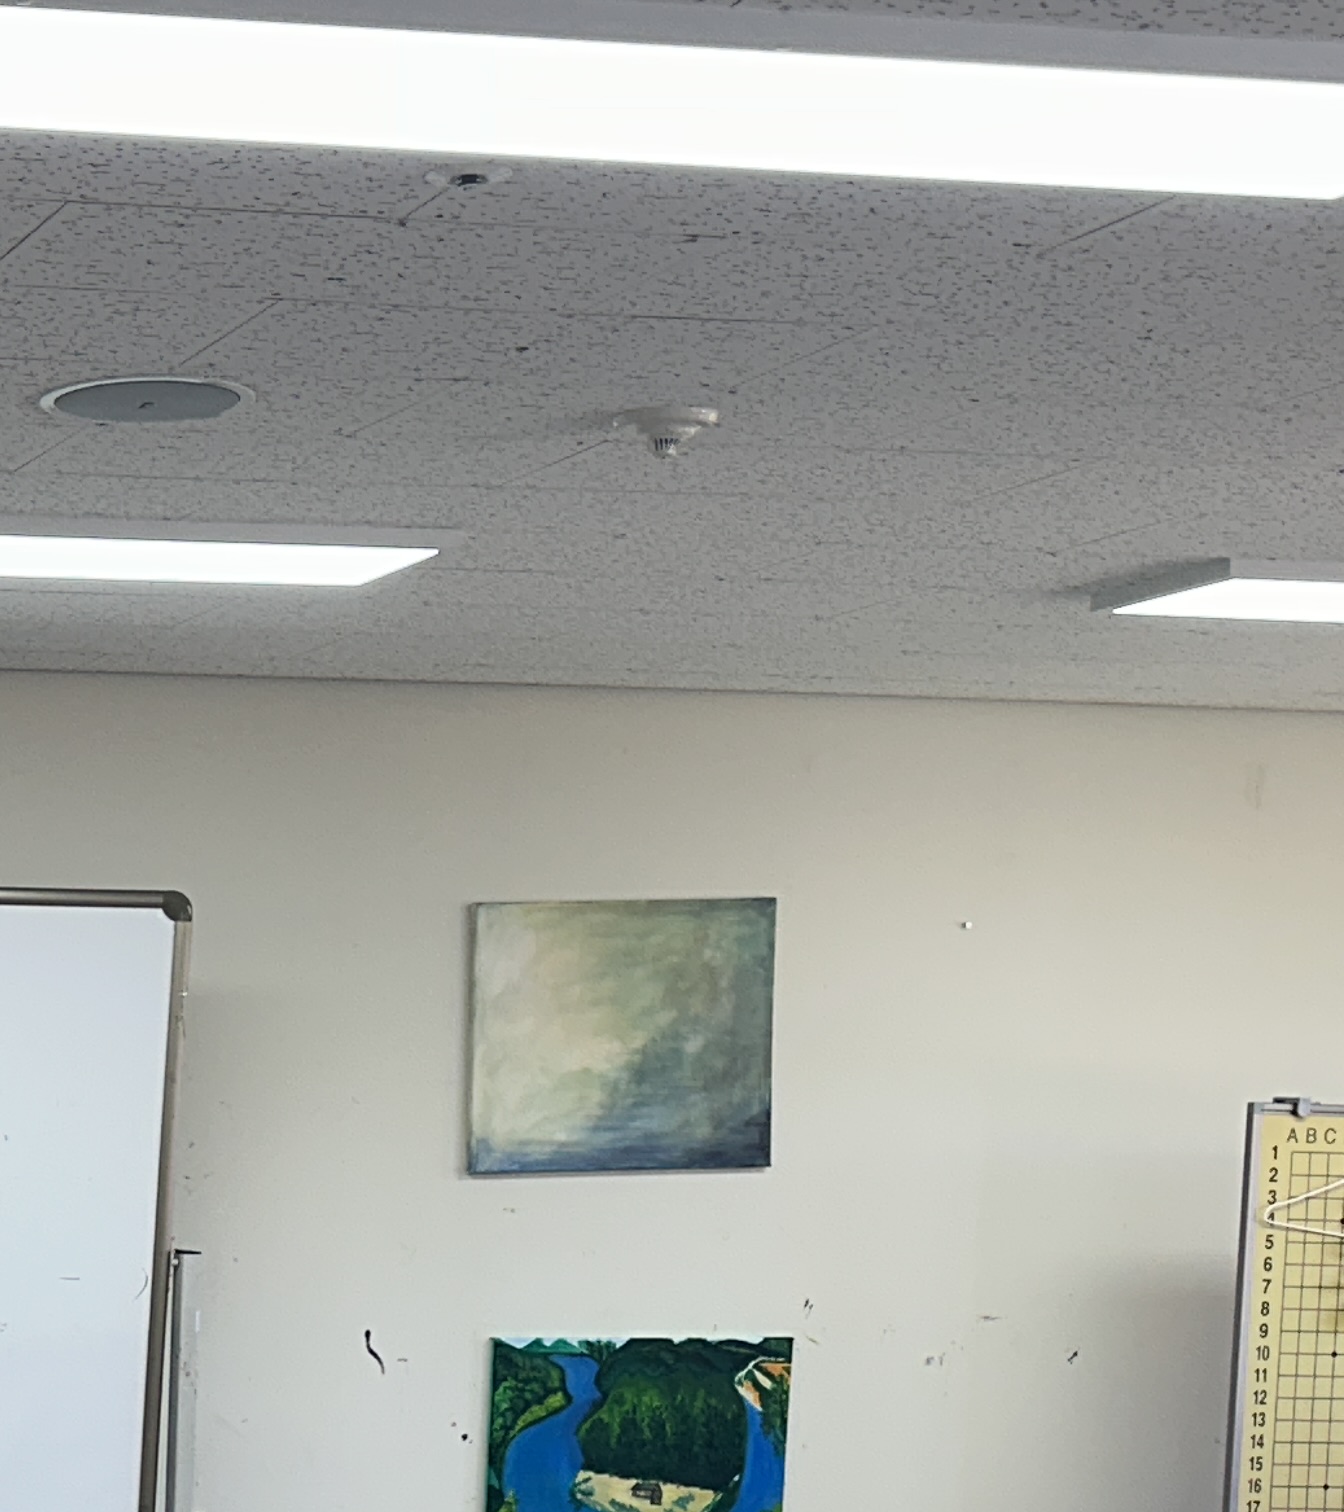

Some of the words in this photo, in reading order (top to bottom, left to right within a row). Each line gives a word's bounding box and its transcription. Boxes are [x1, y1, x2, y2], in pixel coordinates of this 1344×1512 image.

[1286, 1128, 1298, 1143] A
[1306, 1128, 1317, 1144] B
[1324, 1128, 1337, 1144] C
[1272, 1145, 1278, 1160] 1
[1269, 1167, 1278, 1182] 2
[1267, 1190, 1277, 1205] 3
[1264, 1234, 1274, 1249] 5
[1264, 1257, 1272, 1272] 6
[1262, 1279, 1272, 1294] 7
[1261, 1301, 1270, 1316] 8
[1259, 1323, 1269, 1338] 9
[1256, 1345, 1270, 1361] 10
[1254, 1368, 1267, 1383] 11
[1253, 1389, 1267, 1405] 12
[1251, 1412, 1266, 1427] 13
[1250, 1434, 1264, 1449] 14
[1249, 1456, 1263, 1471] 15
[1248, 1478, 1262, 1493] 16
